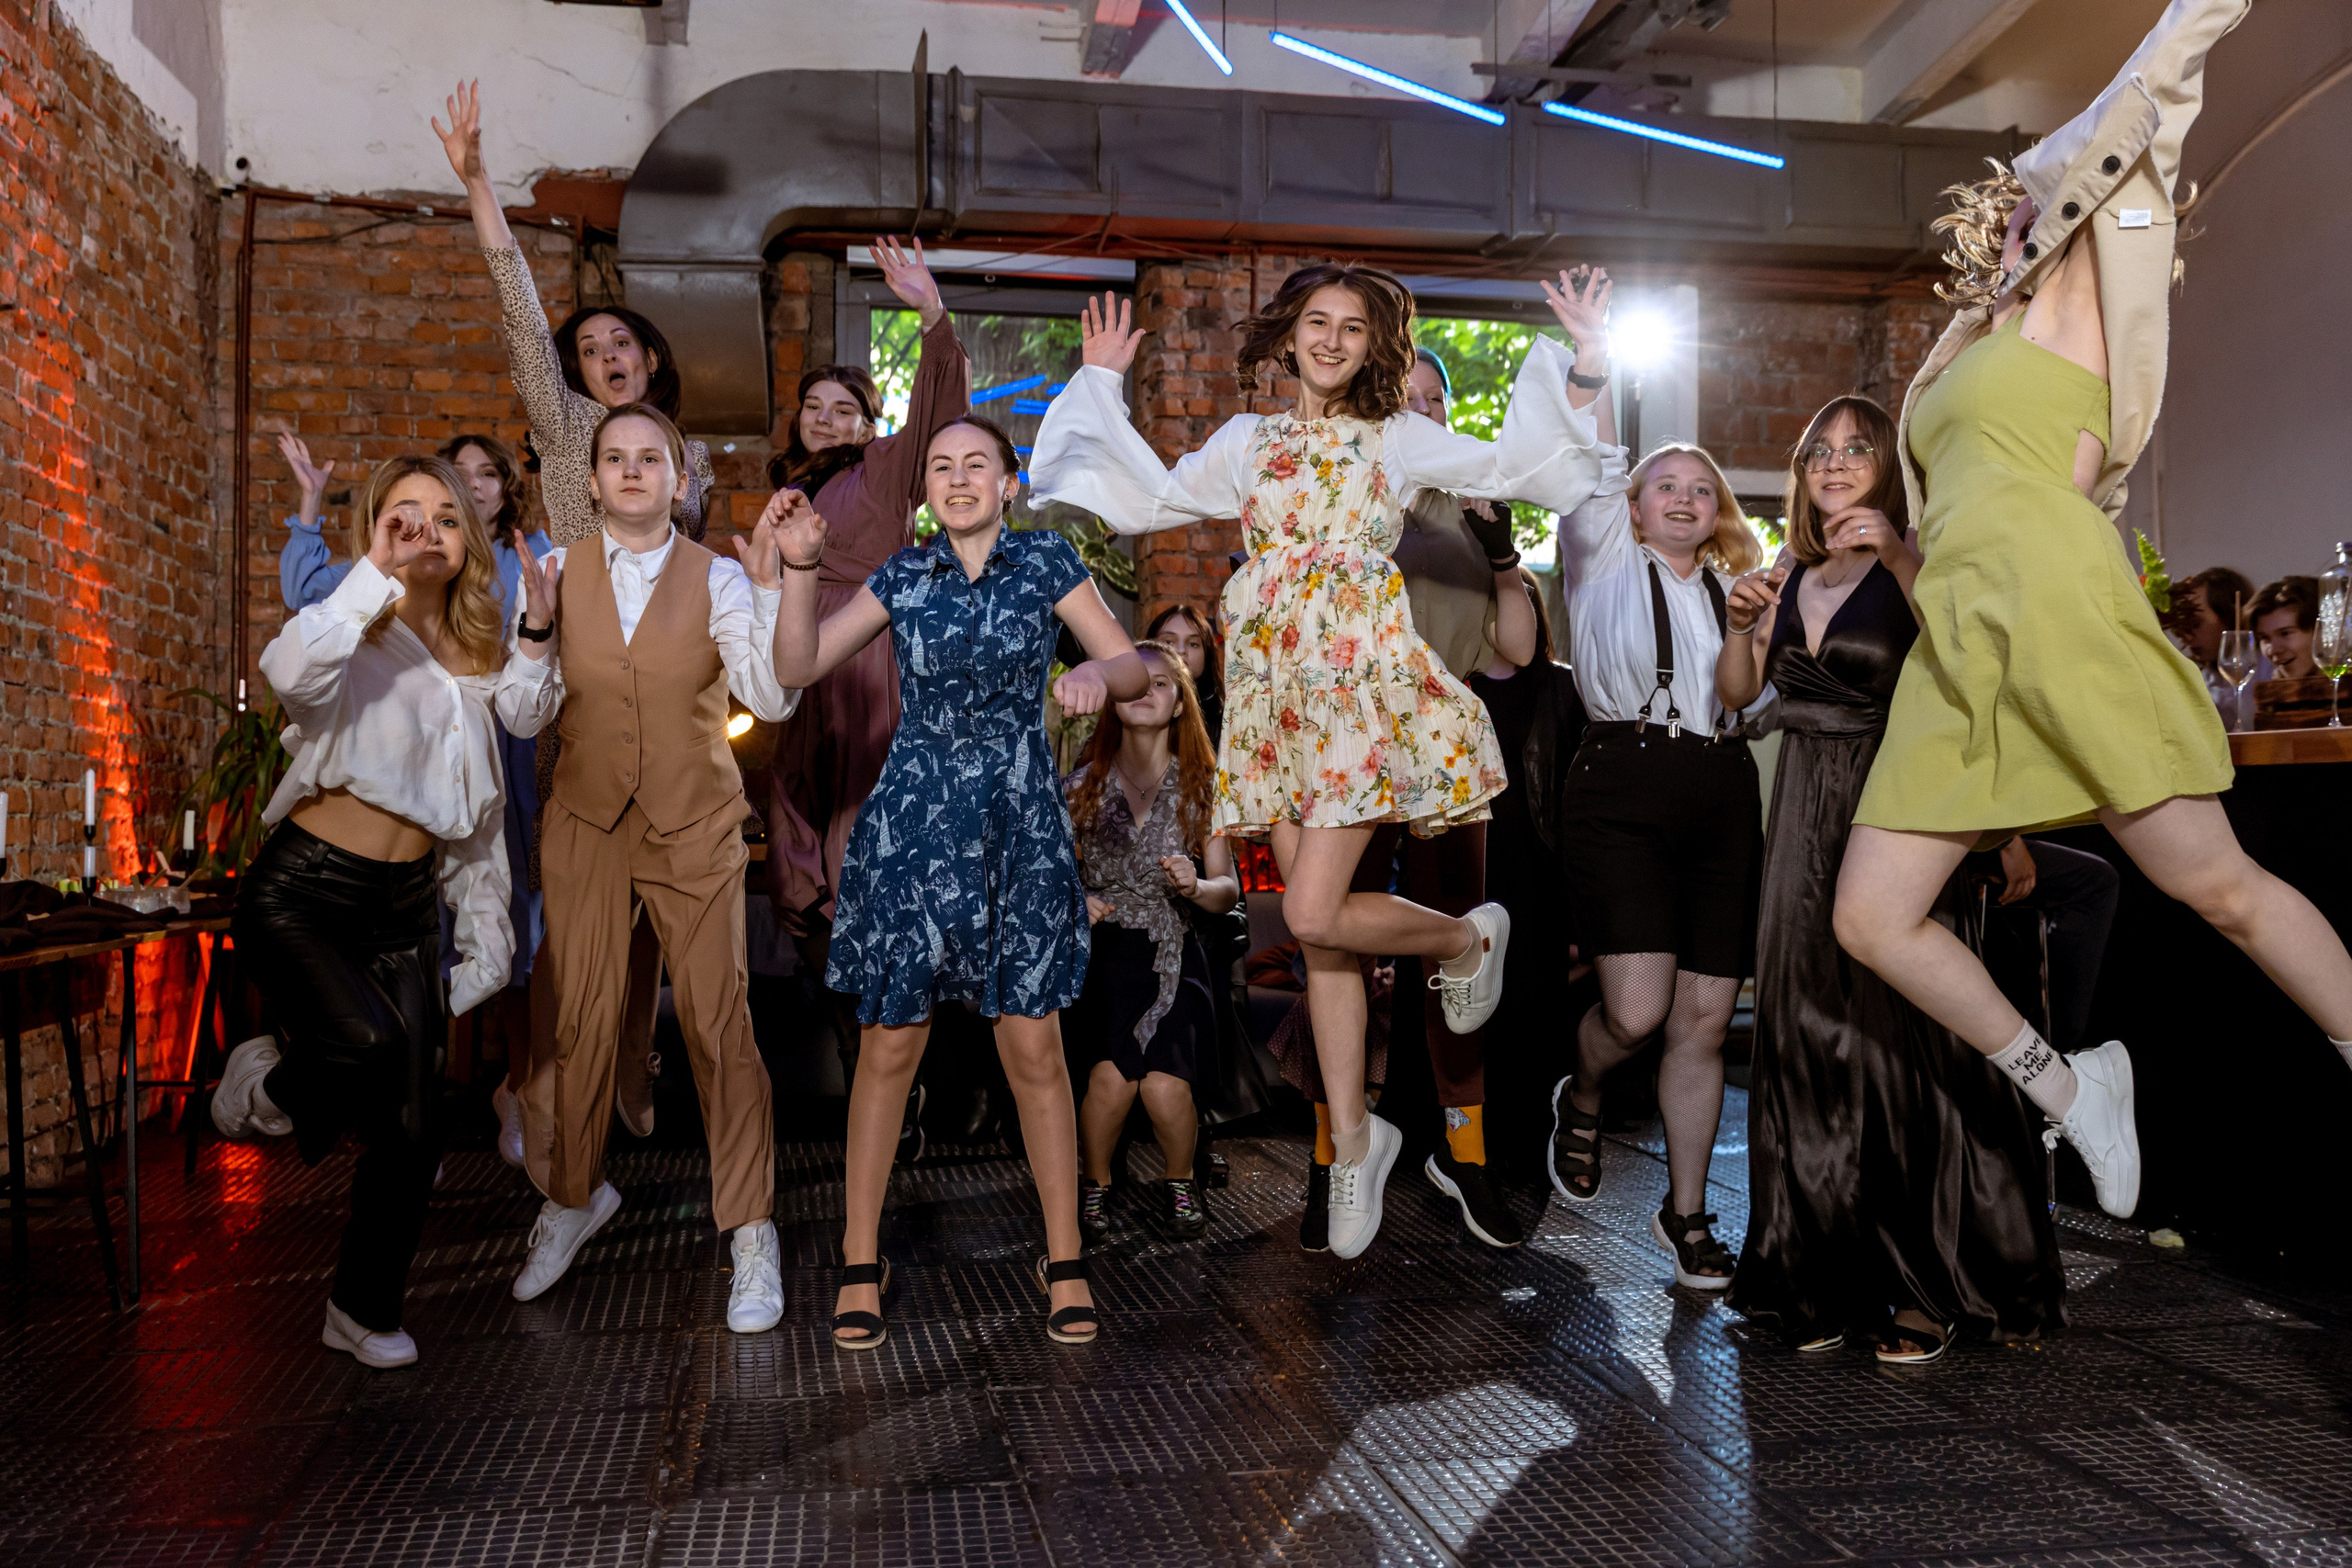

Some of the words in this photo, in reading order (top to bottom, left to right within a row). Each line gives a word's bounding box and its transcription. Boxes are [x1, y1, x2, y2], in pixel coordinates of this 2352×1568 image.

[2007, 1035, 2041, 1071] LEAVE
[2022, 1049, 2054, 1085] ALONE
[2023, 1051, 2042, 1071] ME
